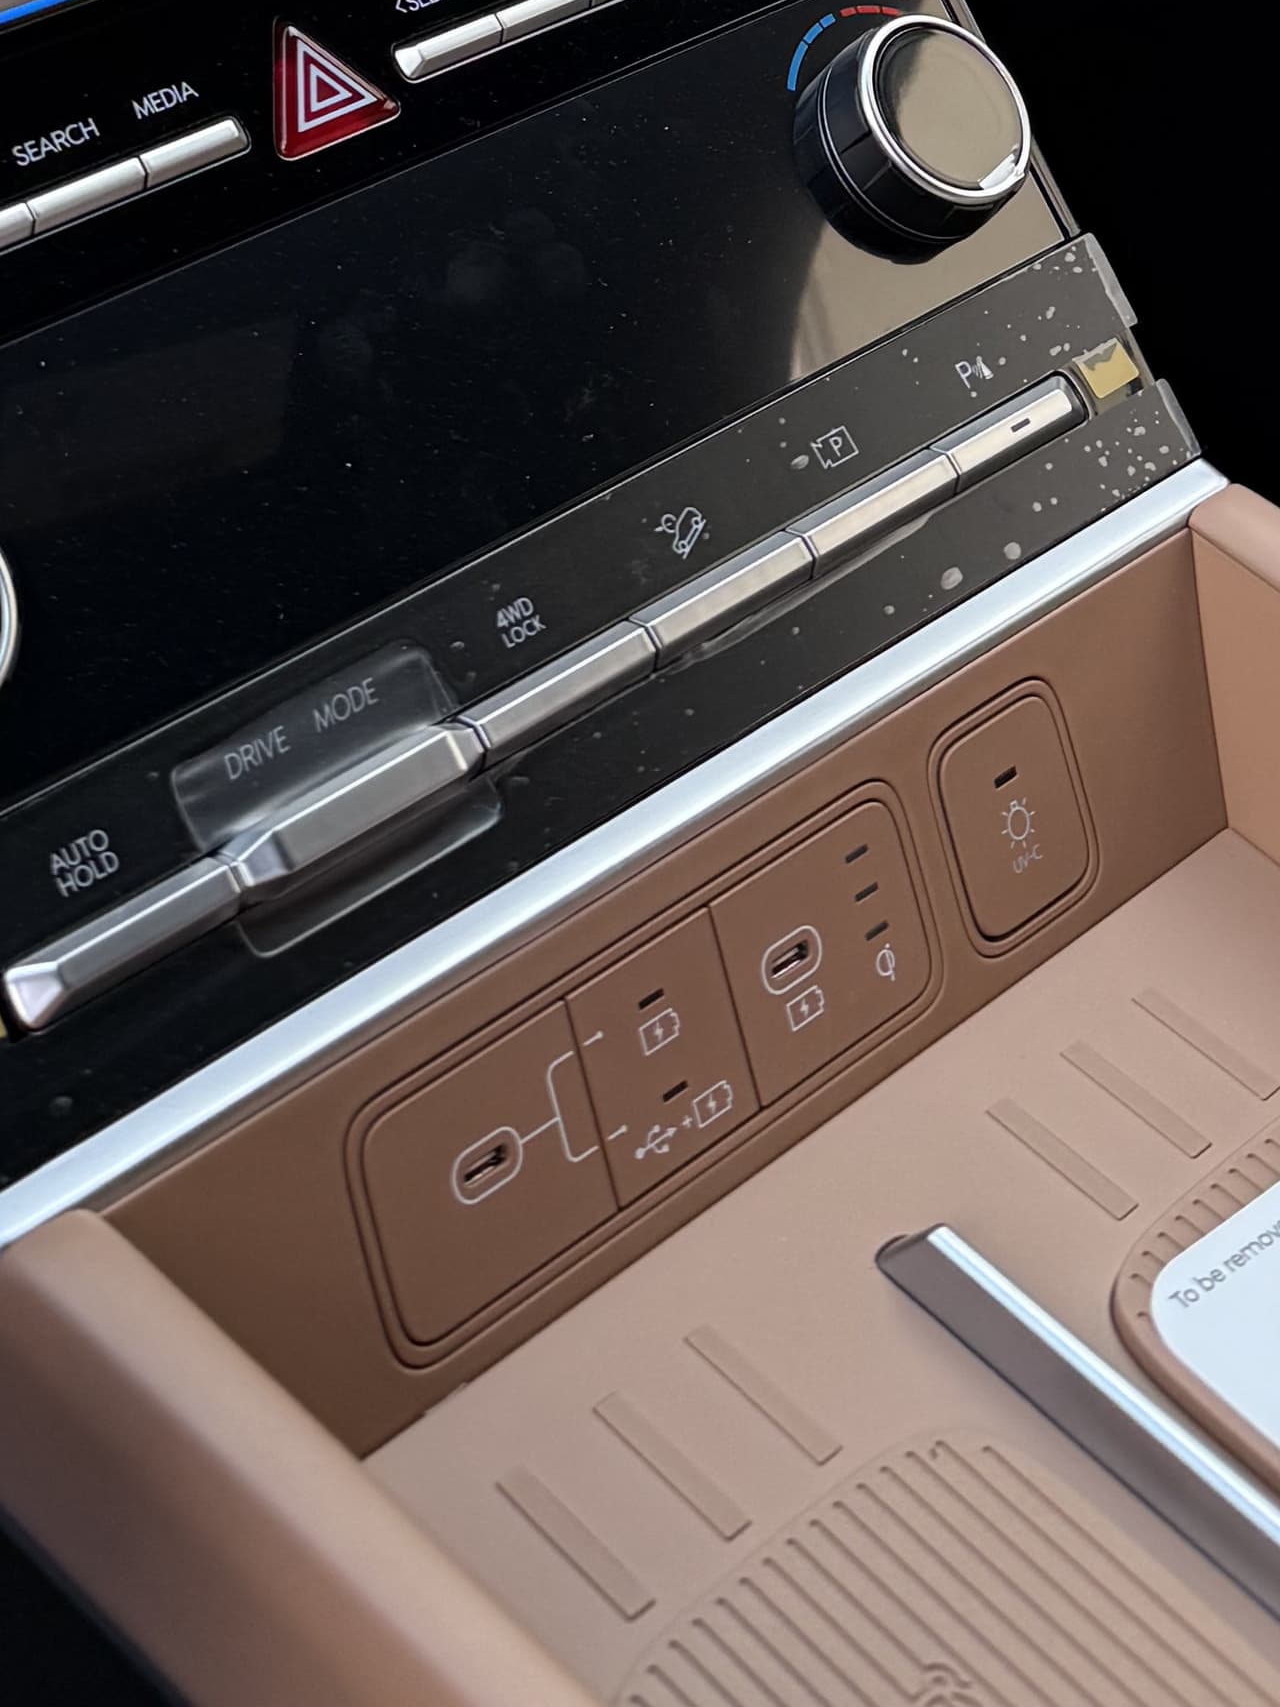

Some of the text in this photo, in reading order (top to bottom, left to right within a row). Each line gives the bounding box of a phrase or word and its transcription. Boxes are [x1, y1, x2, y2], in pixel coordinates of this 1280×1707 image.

[132, 81, 200, 120] MEDIA
[12, 117, 100, 167] SEARCH
[496, 597, 535, 629] 4WD
[500, 615, 547, 649] LOCK
[224, 678, 380, 782] DRIVE MODE
[50, 828, 110, 876] AUTO
[56, 851, 120, 898] HOLD
[1169, 1289, 1201, 1310] To
[1193, 1268, 1226, 1293] be
